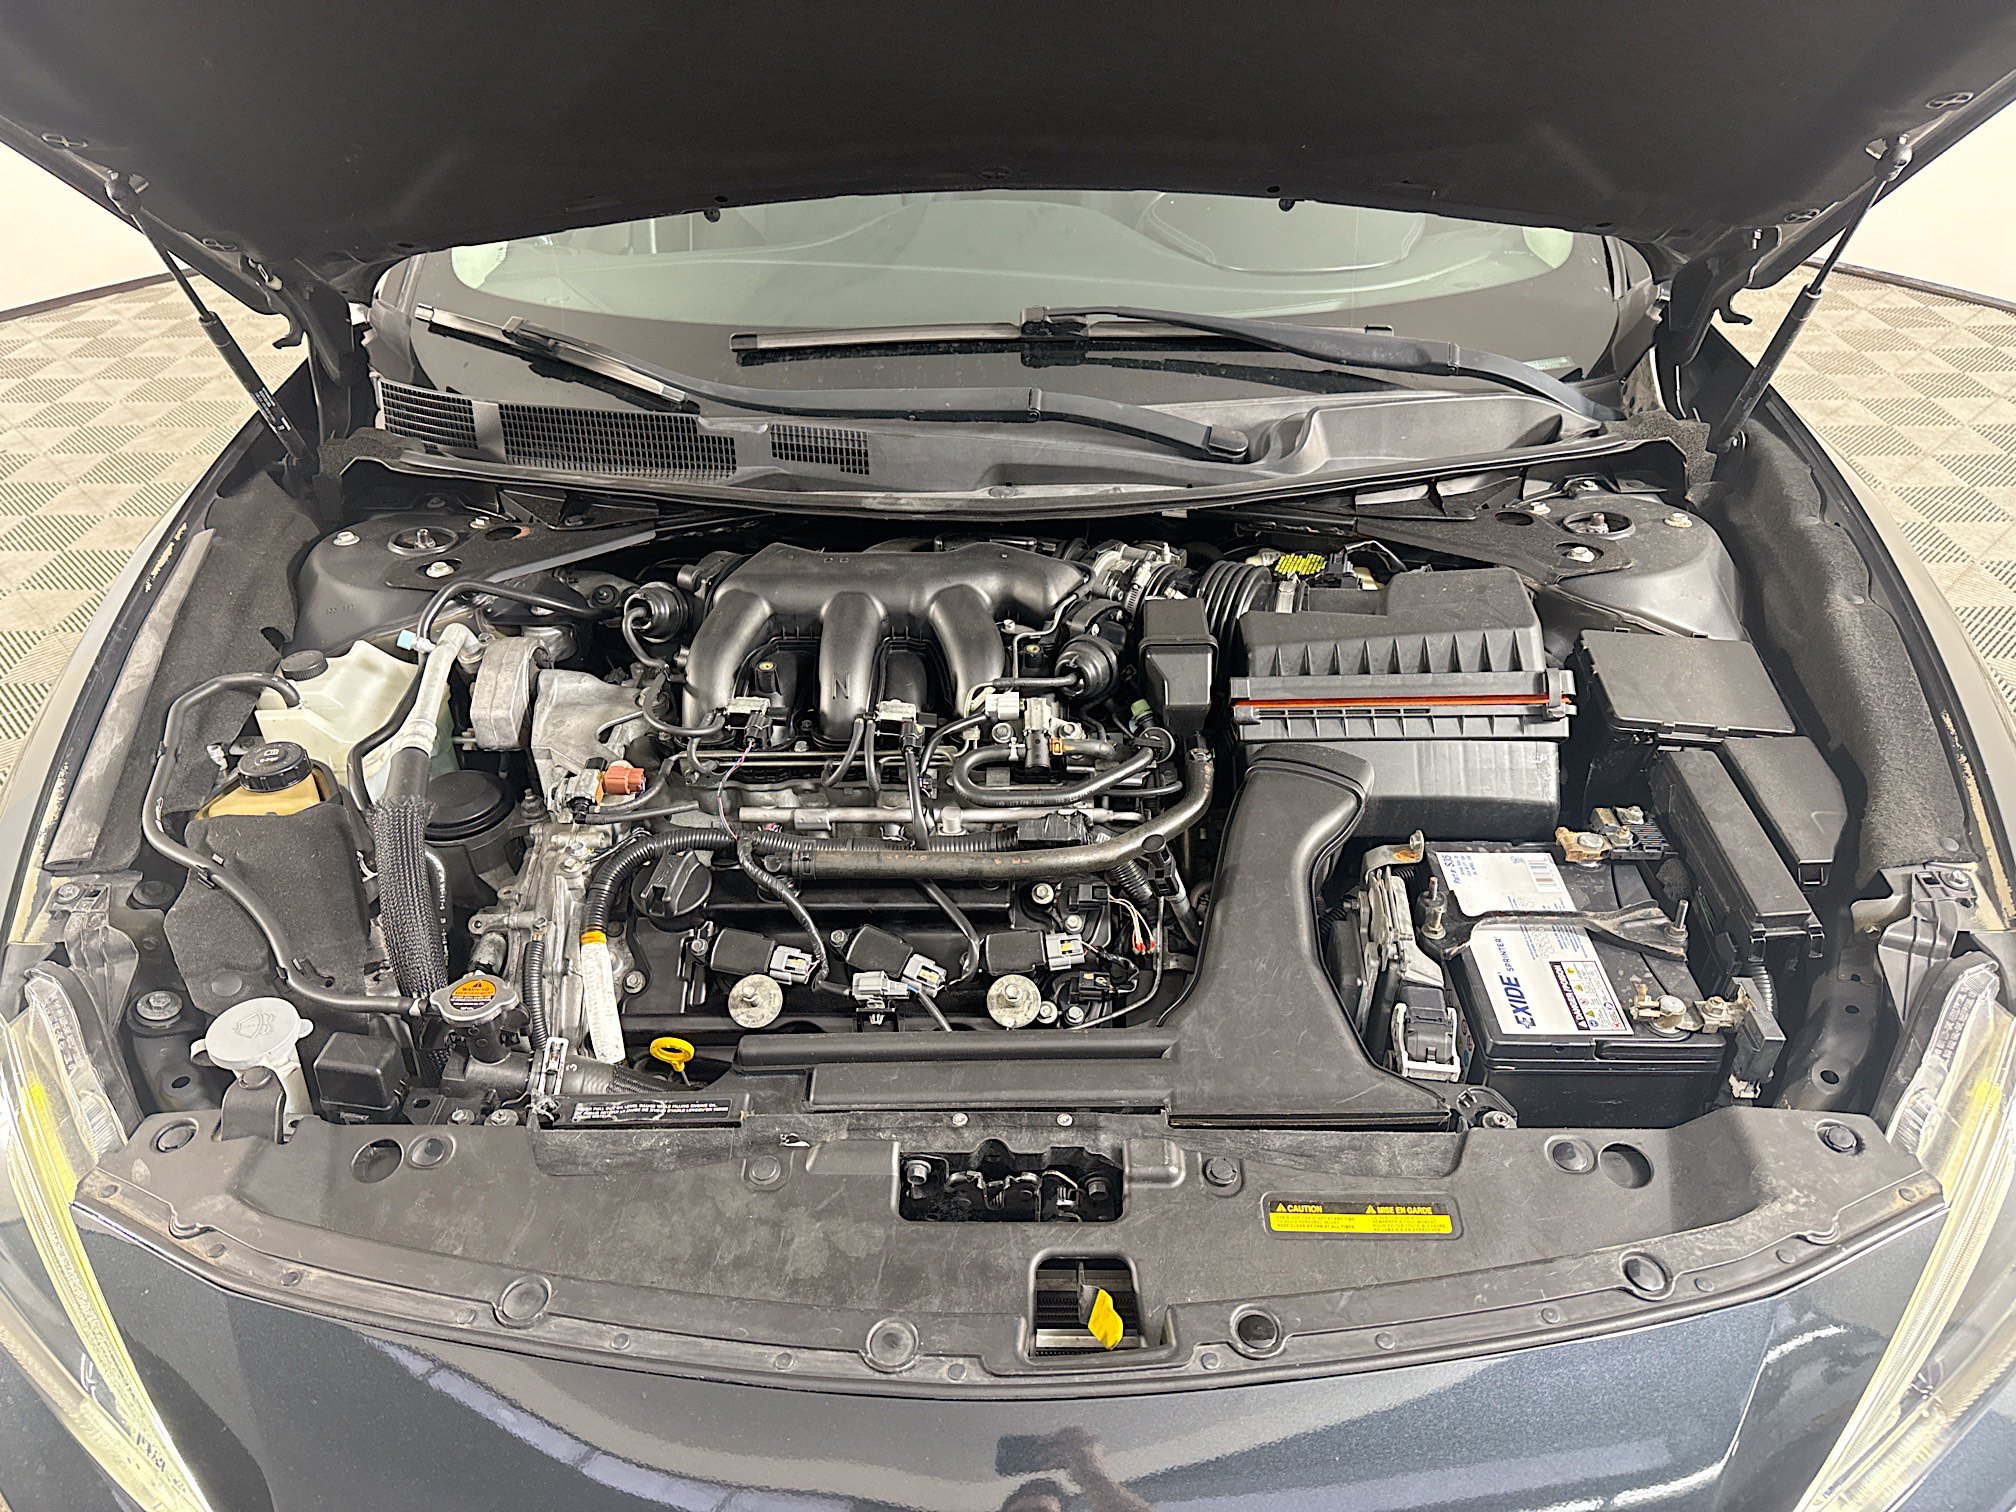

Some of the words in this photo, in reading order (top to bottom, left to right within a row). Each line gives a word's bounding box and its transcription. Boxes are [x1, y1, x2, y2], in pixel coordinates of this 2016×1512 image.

[1494, 937, 1514, 972] SPRINTER
[1499, 974, 1536, 1029] EXIDE
[1286, 1204, 1323, 1213] CAUTION
[1376, 1206, 1395, 1214] MISE
[1395, 1206, 1406, 1214] EN
[1406, 1206, 1433, 1215] GARDE
